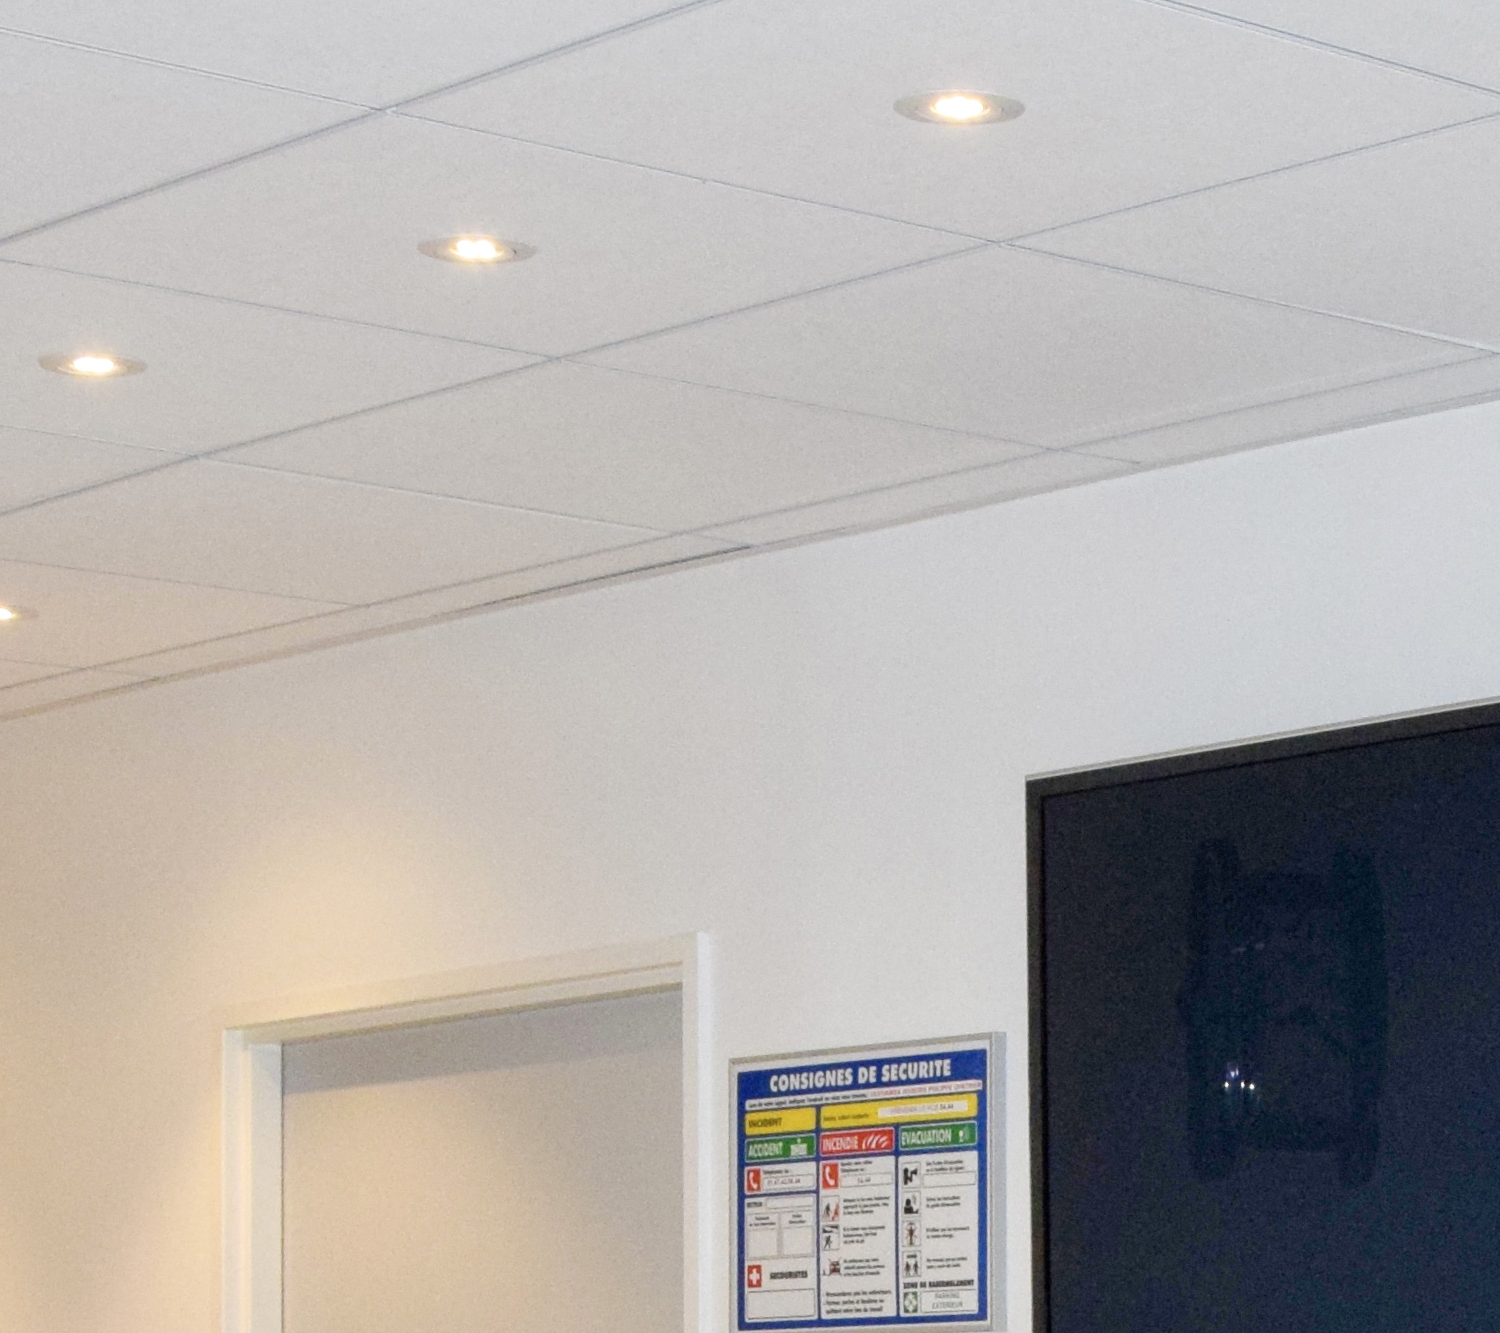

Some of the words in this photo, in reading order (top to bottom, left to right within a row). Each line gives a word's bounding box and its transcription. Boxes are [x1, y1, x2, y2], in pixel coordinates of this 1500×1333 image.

[770, 1069, 853, 1092] CONSIGNES
[858, 1066, 876, 1083] DE
[881, 1059, 951, 1081] SECURITE
[822, 1136, 858, 1151] INCENDIE
[900, 1128, 952, 1145] EVACUATION
[748, 1141, 784, 1157] ACCIDENT
